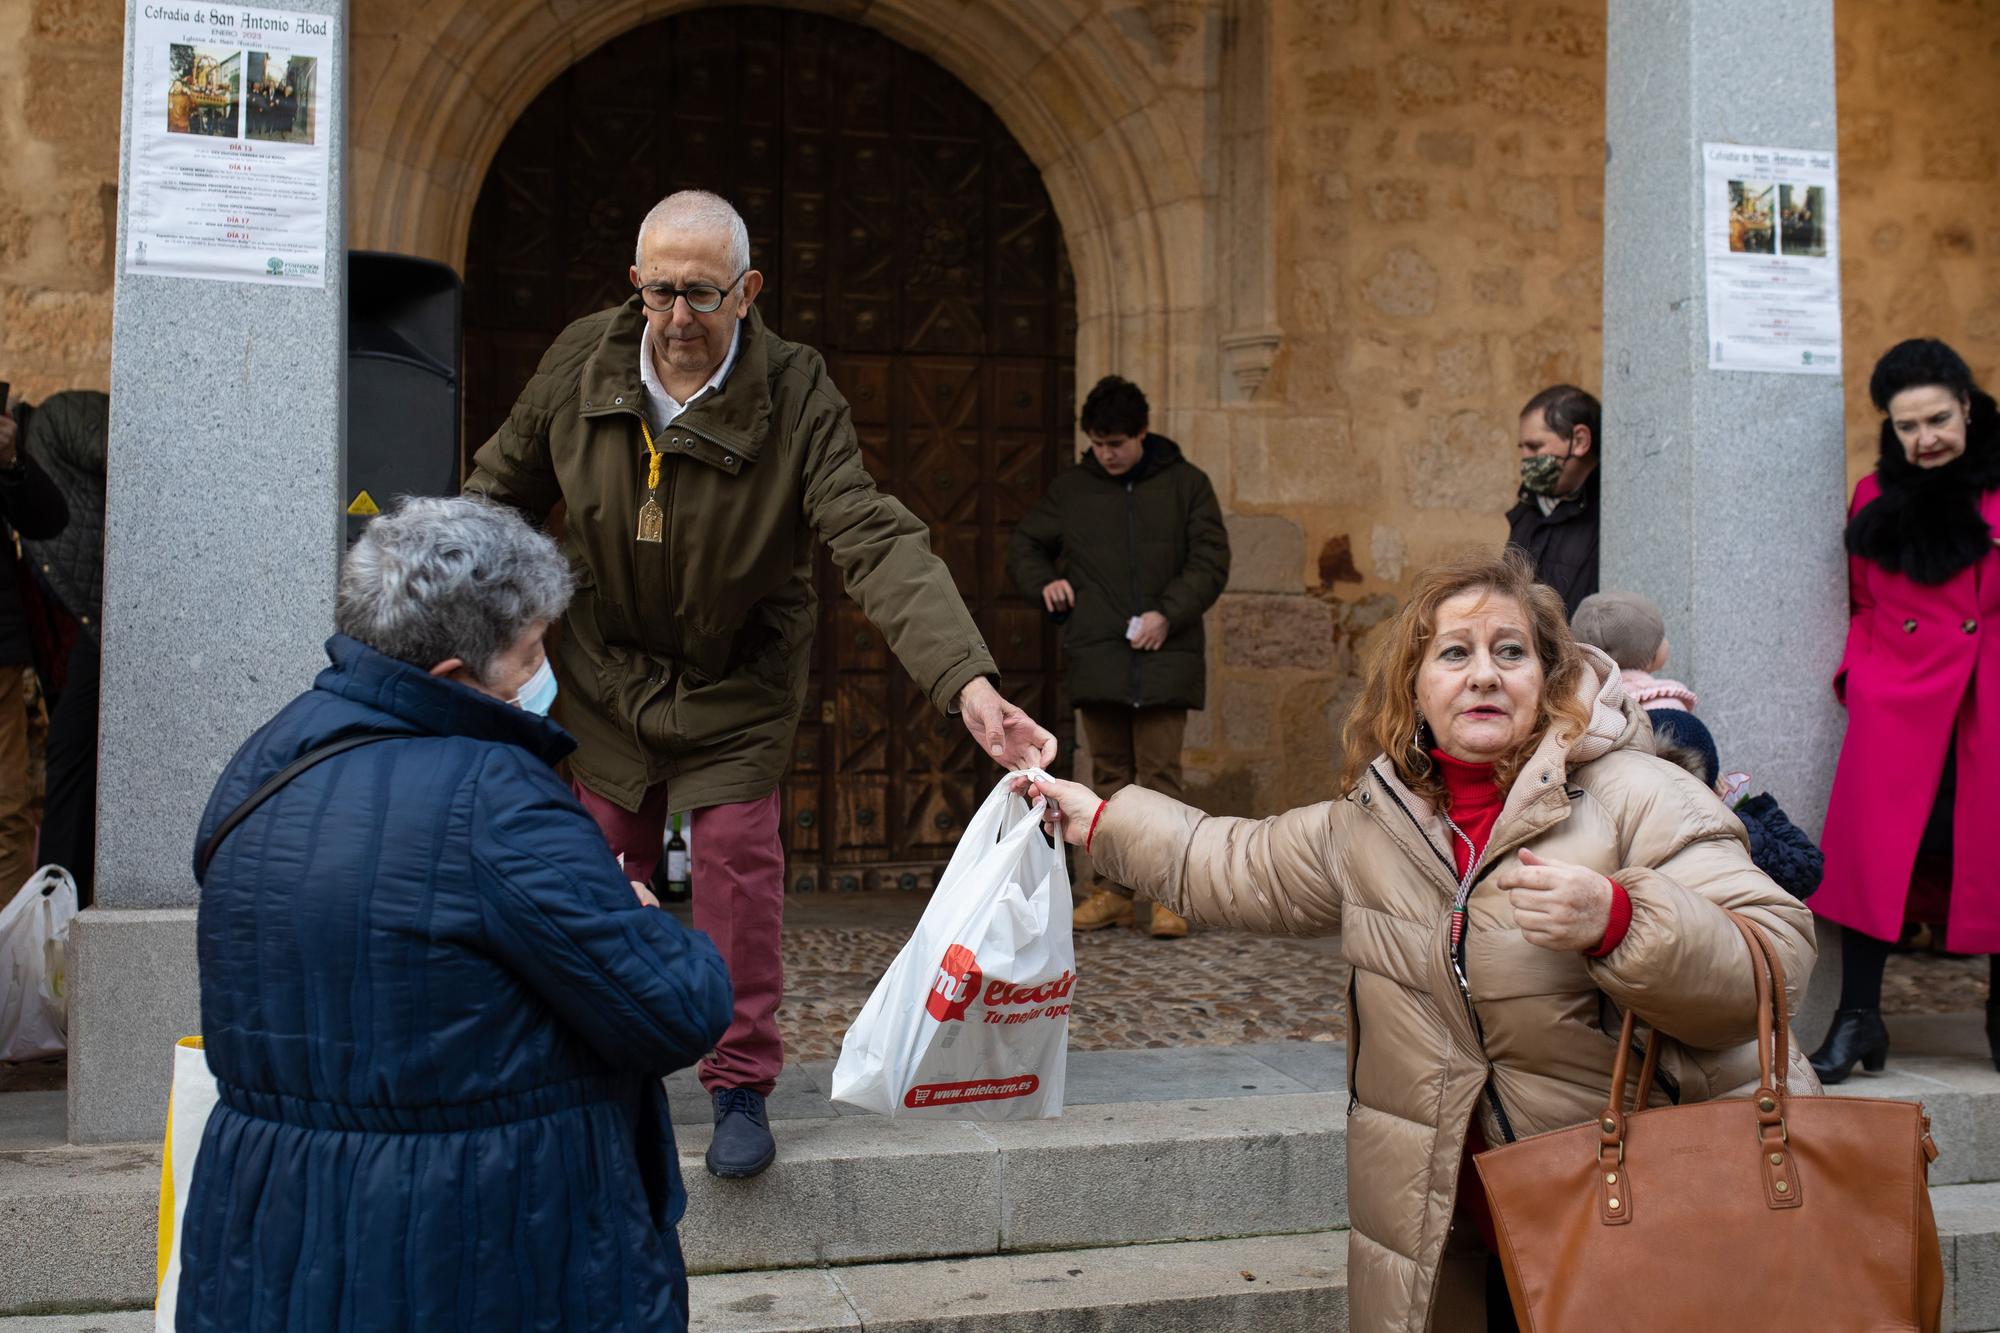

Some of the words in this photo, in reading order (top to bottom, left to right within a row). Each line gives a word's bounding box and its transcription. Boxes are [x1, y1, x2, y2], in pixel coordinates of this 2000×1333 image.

[194, 10, 205, 24] de
[209, 9, 234, 27] San
[240, 12, 289, 32] Antonio
[295, 18, 327, 36] Abad
[211, 29, 238, 37] ENERO
[242, 31, 262, 40] 2023
[229, 143, 242, 151] DÍA
[229, 163, 241, 171] DÍA
[226, 215, 239, 223] DÍA
[226, 231, 240, 239] DÍA
[936, 967, 972, 1004] mi
[983, 1010, 1004, 1025] Tu
[1004, 1007, 1044, 1025] mejor
[933, 1080, 1032, 1100] www.mielectro.es
